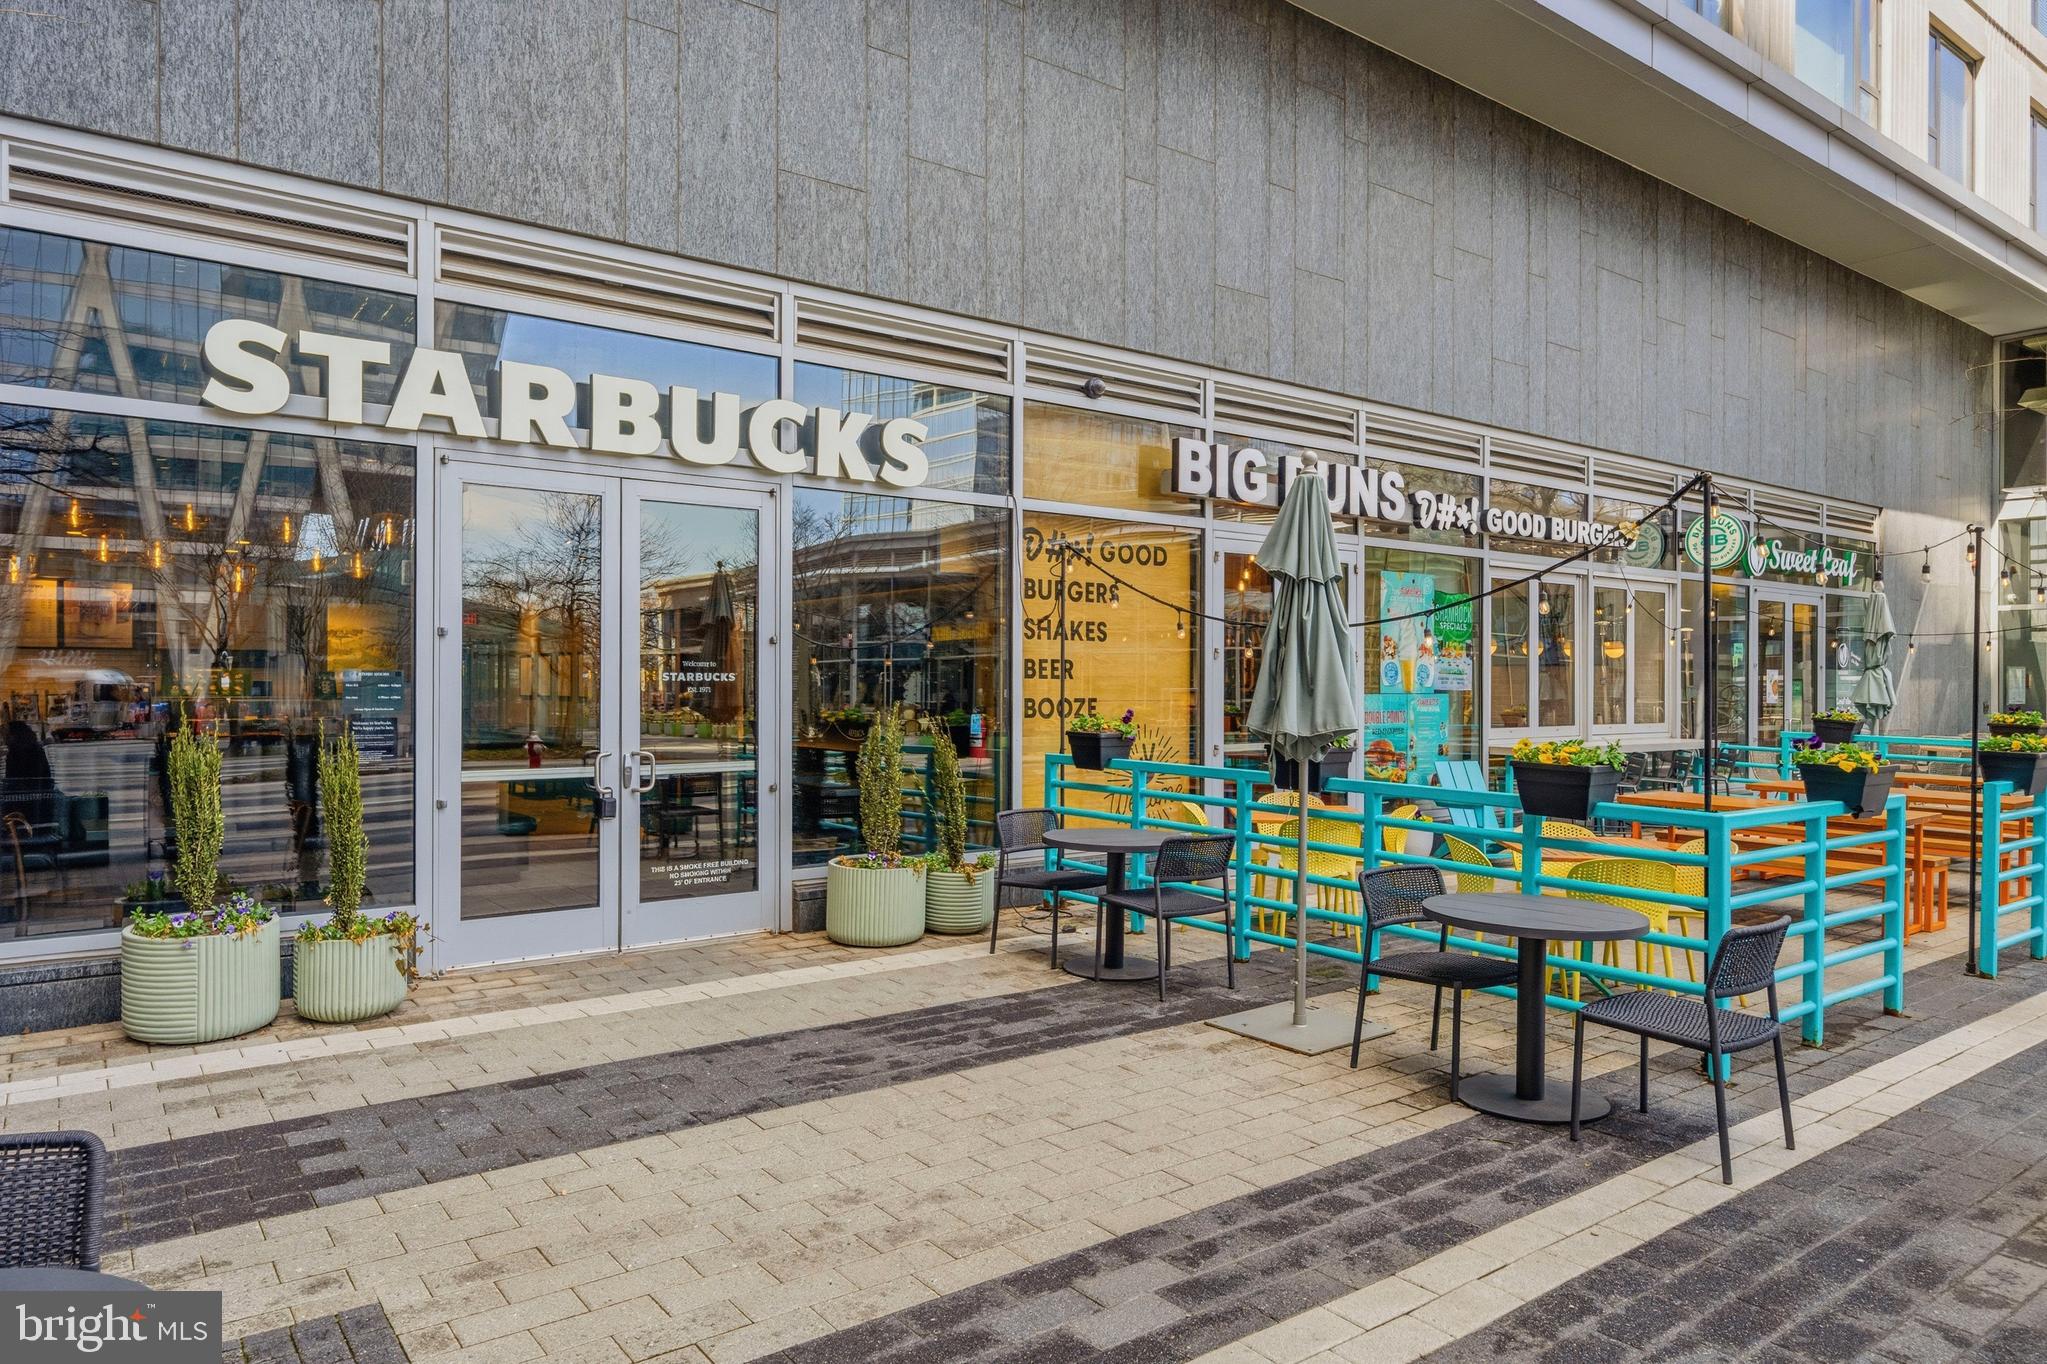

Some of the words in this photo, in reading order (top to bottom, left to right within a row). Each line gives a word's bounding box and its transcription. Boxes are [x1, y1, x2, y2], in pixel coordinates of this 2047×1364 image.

[201, 319, 929, 487] STARBUCKS
[1173, 437, 1267, 503] BIG
[1486, 507, 1547, 539] GOOD
[1551, 516, 1637, 551] BURGER
[1100, 540, 1168, 567] GOOD
[1769, 539, 1817, 574] Sweet
[1821, 548, 1858, 586] Leaf
[1023, 617, 1108, 643] SHAKES
[1440, 621, 1467, 631] SPECIALS
[662, 672, 736, 682] STARBUCKS
[1024, 658, 1074, 680] BEER
[1024, 697, 1098, 720] BOOZE
[680, 863, 702, 871] SMOKE
[720, 859, 749, 867] BUILDING
[680, 869, 709, 878] SMOKING
[710, 867, 732, 875] WITHIN
[693, 875, 727, 884] ENTRANCE
